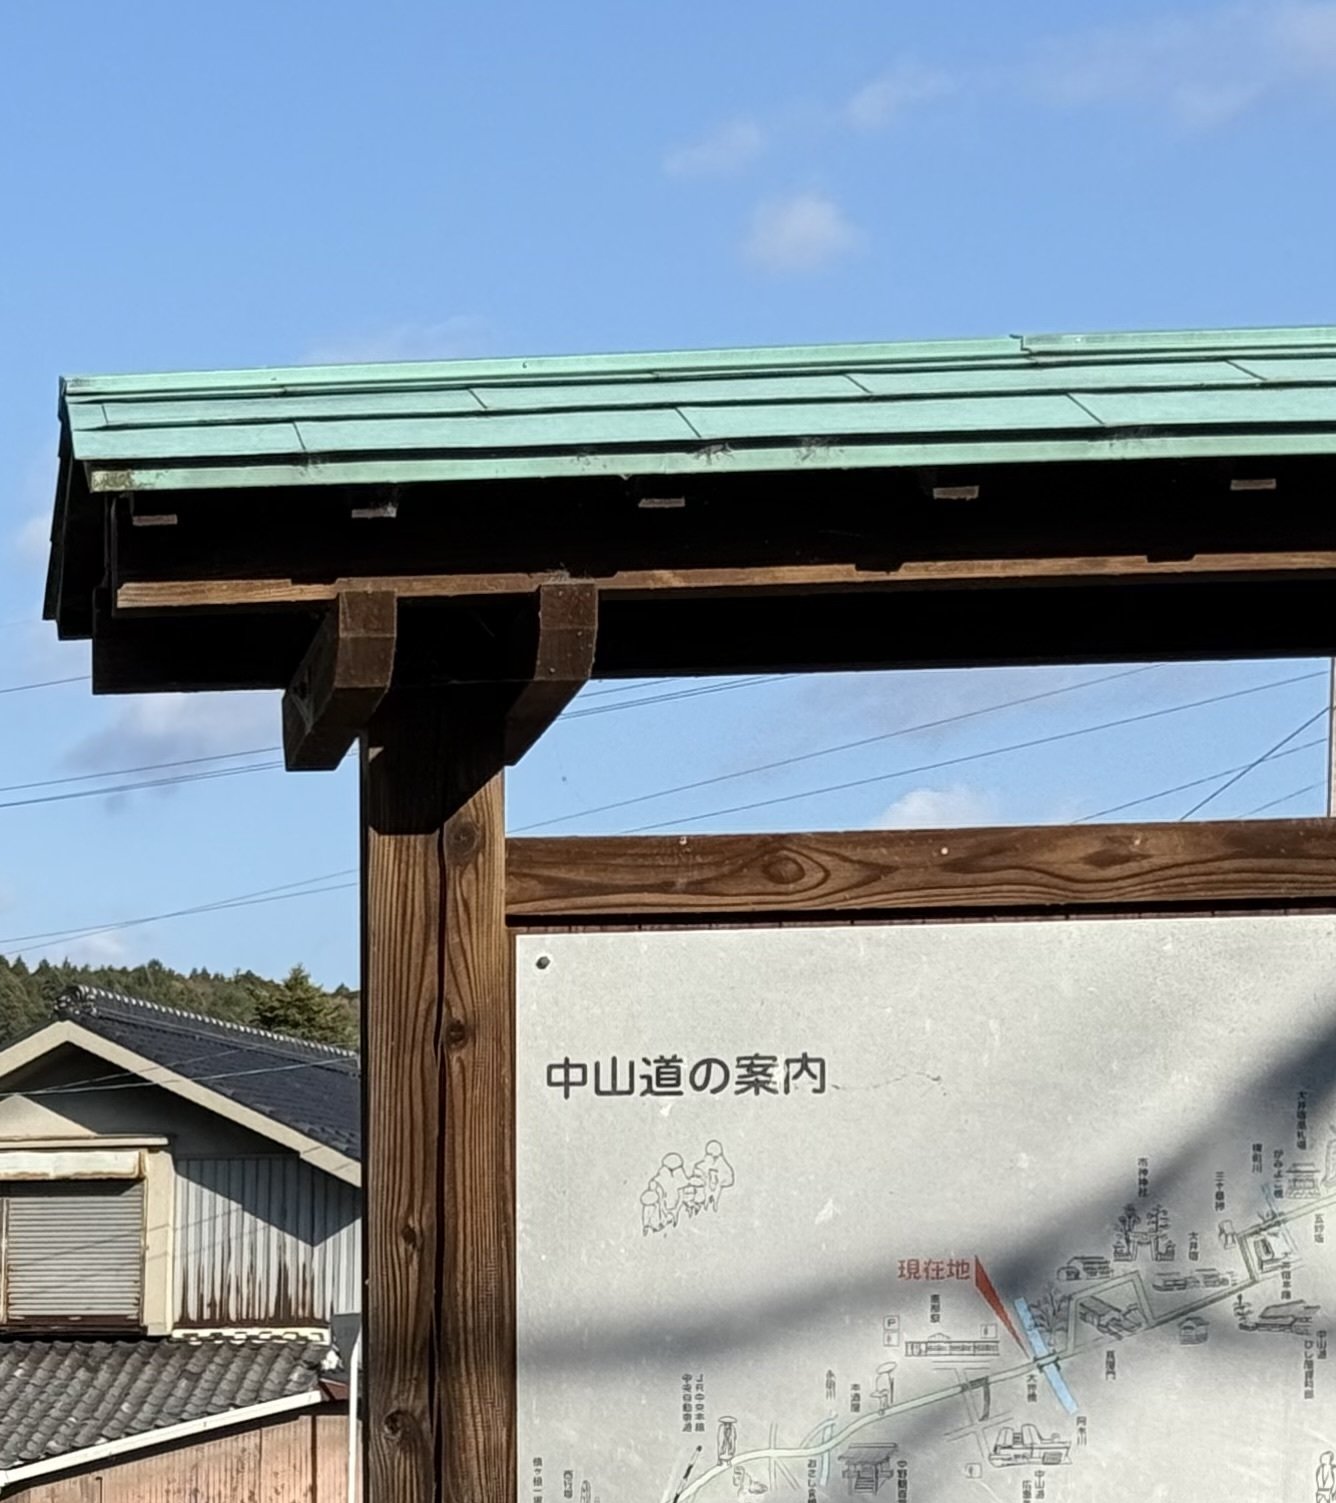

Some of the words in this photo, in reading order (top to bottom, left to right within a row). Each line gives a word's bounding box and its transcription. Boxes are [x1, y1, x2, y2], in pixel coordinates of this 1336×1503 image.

[547, 1052, 826, 1100] 中山道の案内
[898, 1259, 970, 1280] 現在地
